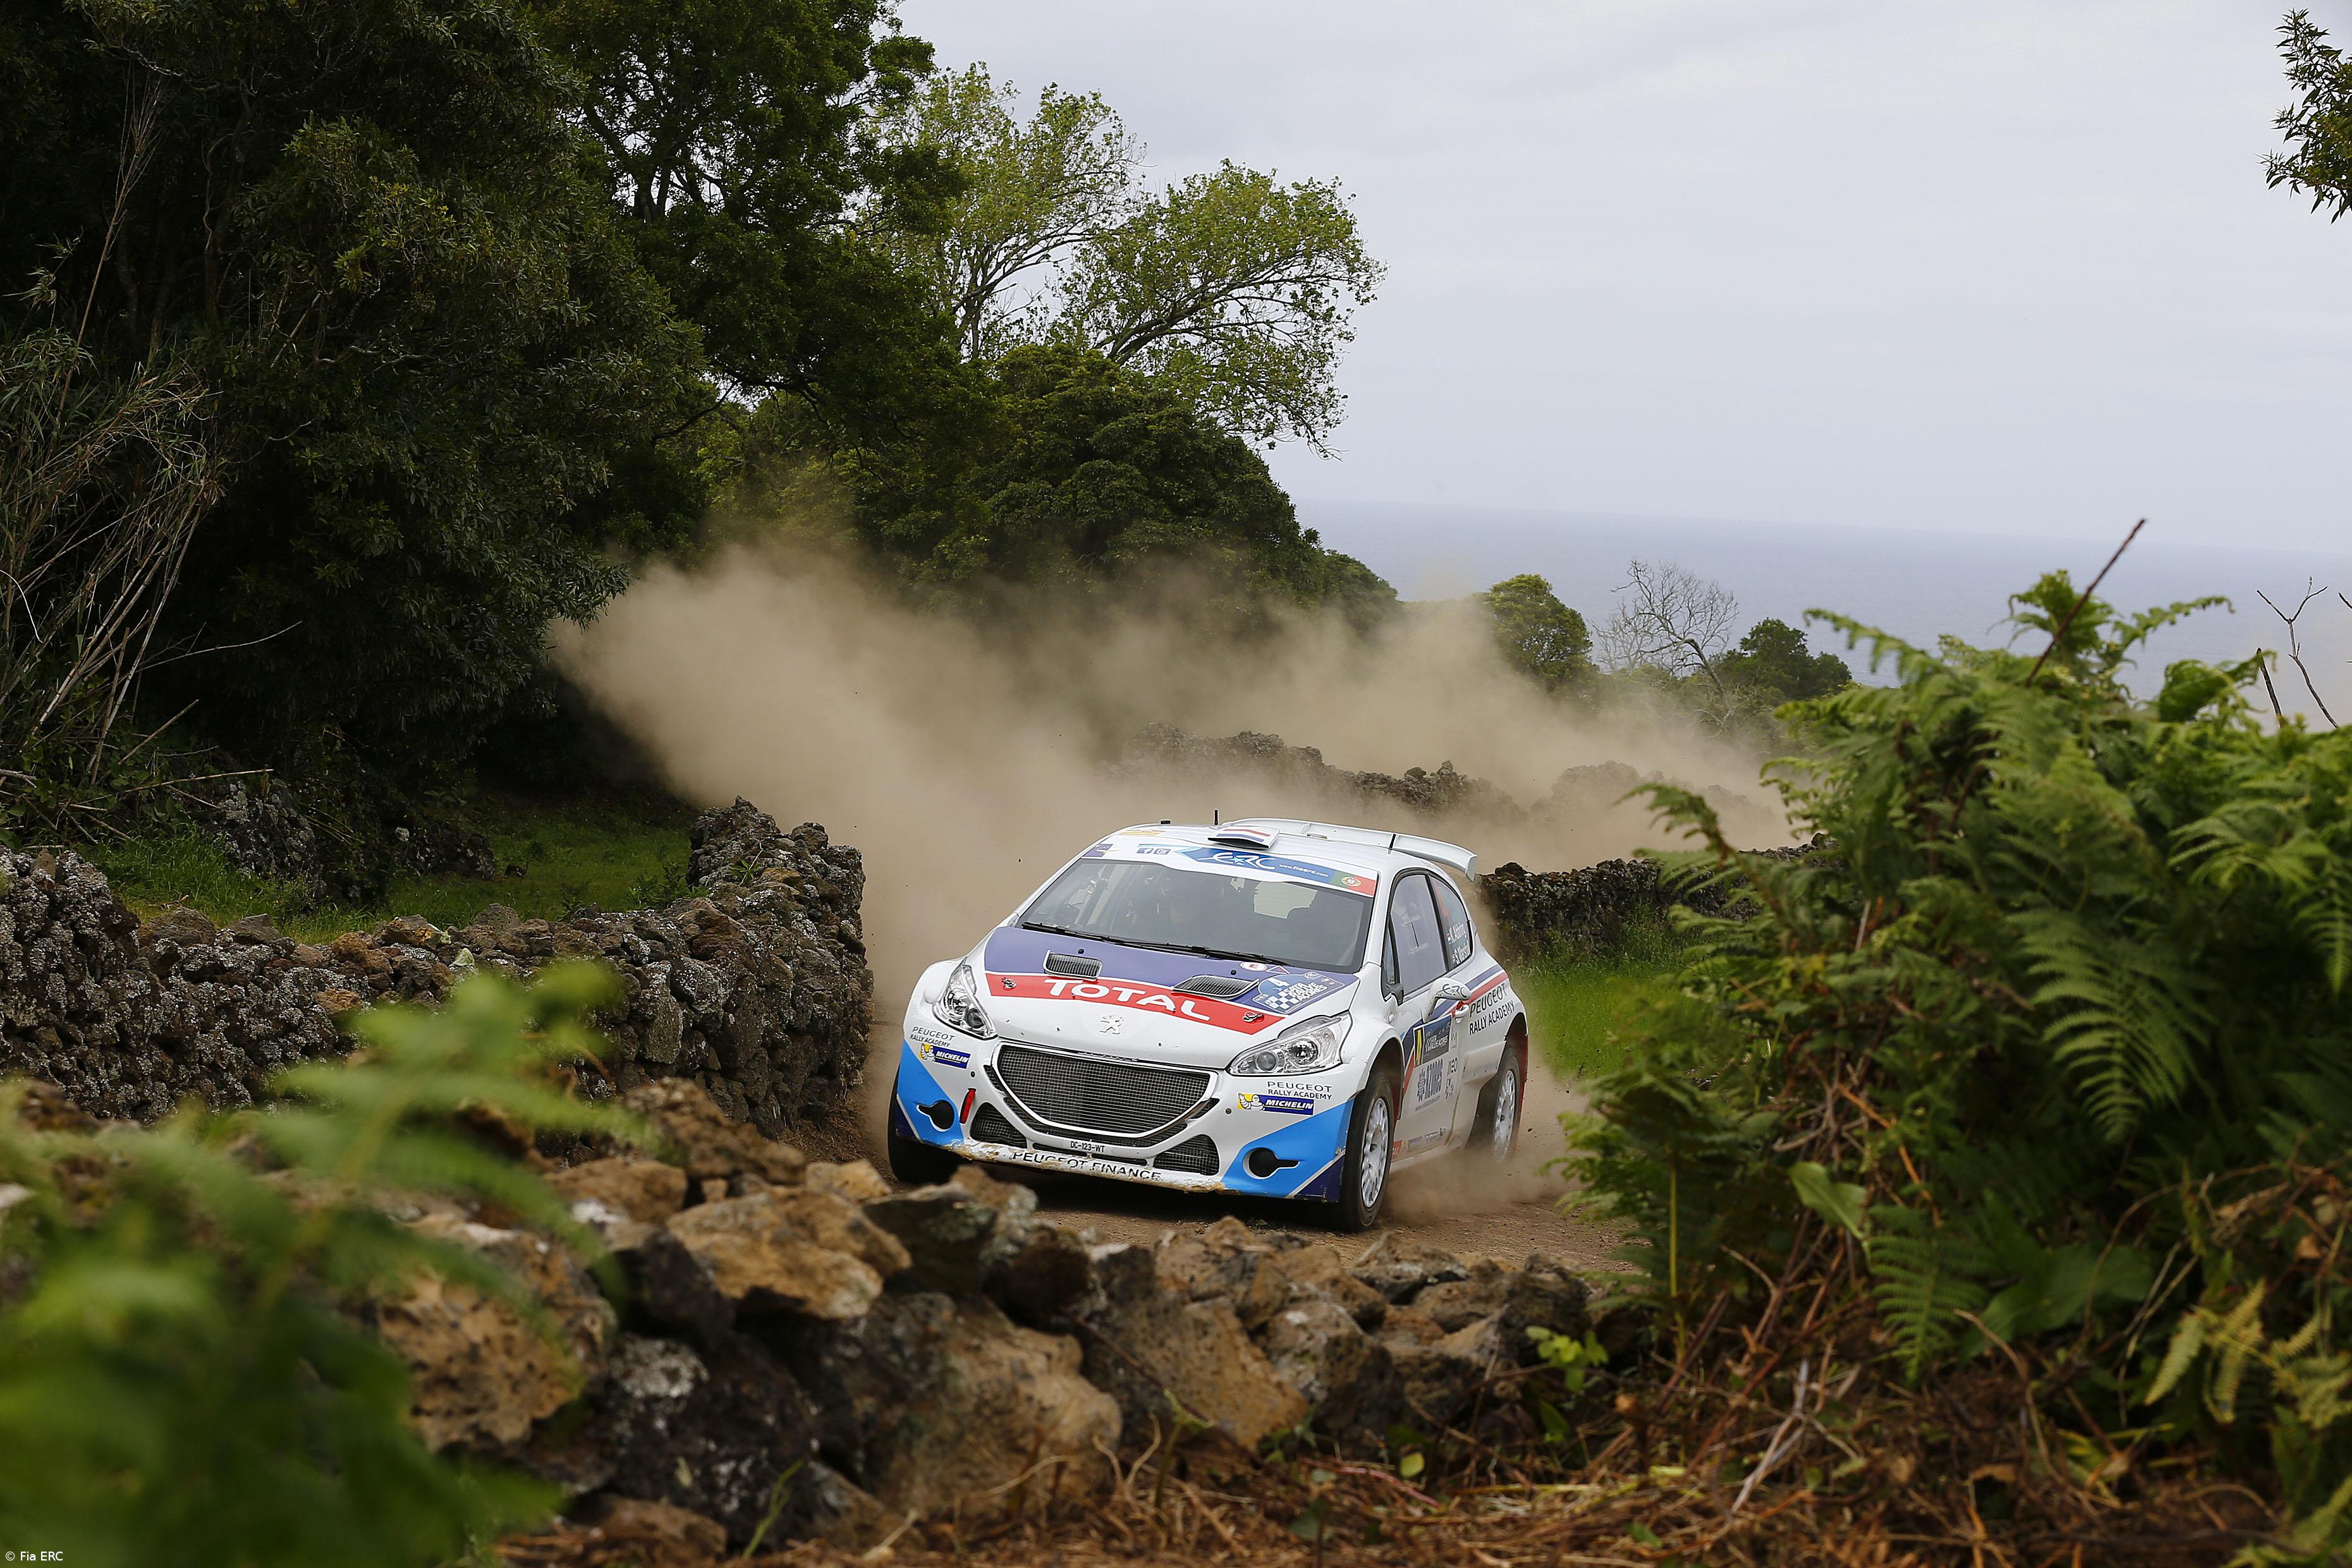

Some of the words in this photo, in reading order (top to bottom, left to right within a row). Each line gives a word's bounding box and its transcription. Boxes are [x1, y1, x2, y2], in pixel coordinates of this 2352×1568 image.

[1198, 852, 1276, 870] ERC
[1044, 979, 1211, 1021] TOTAL
[1469, 983, 1508, 1018] PEUGEOT
[1469, 1015, 1488, 1036] RALLY
[1488, 1000, 1515, 1026] ACADEMY
[910, 1034, 925, 1042] RALLY
[924, 1037, 951, 1048] ACADEMY
[912, 1026, 956, 1042] PEUGEOT
[935, 1050, 970, 1063] MICHELIN
[1267, 1081, 1332, 1093] PEUGEOT
[1294, 1091, 1332, 1100] ACADEMY
[1265, 1099, 1313, 1109] MICHELIN
[1070, 1141, 1106, 1153] DC-123-WT
